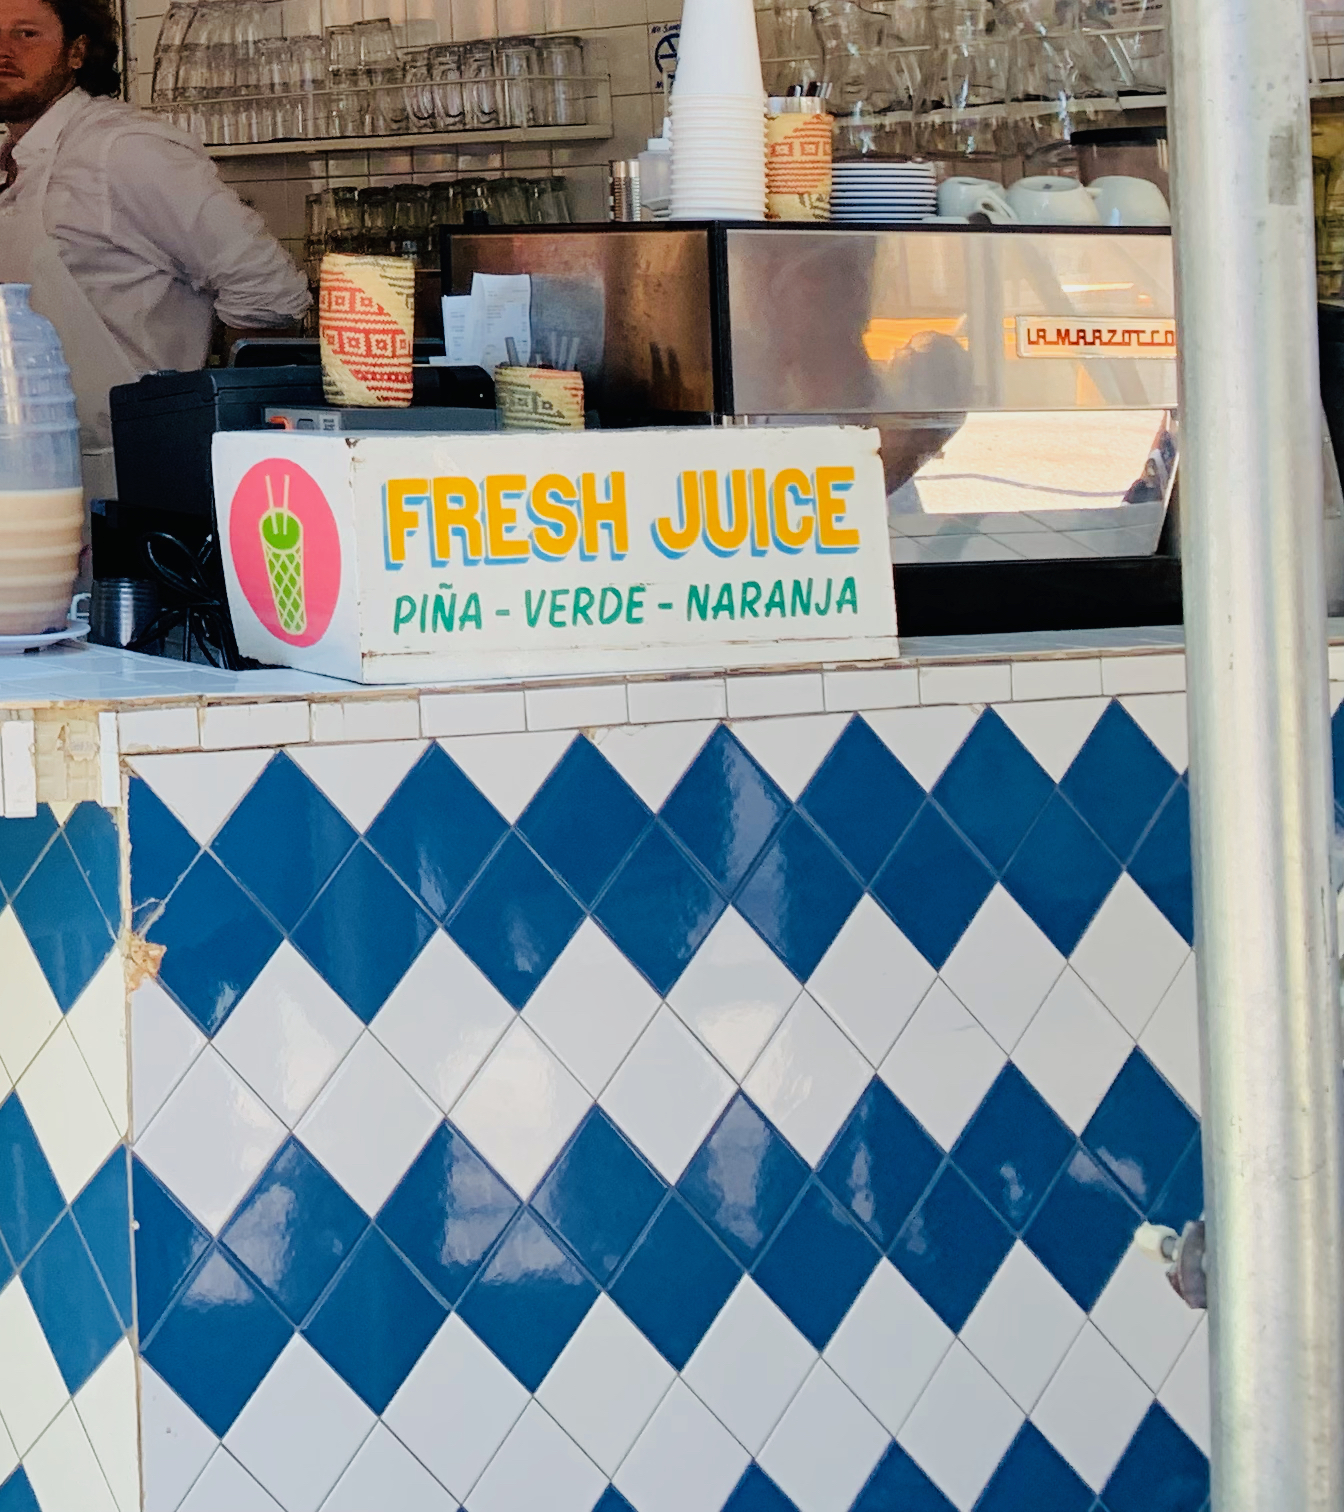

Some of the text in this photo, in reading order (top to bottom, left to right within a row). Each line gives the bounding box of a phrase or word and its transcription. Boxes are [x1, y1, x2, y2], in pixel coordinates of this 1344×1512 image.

[384, 466, 861, 571] FRESH JUICE
[393, 582, 483, 637] PIÑA
[524, 582, 647, 629] VERDE
[685, 575, 859, 624] NARANJA
